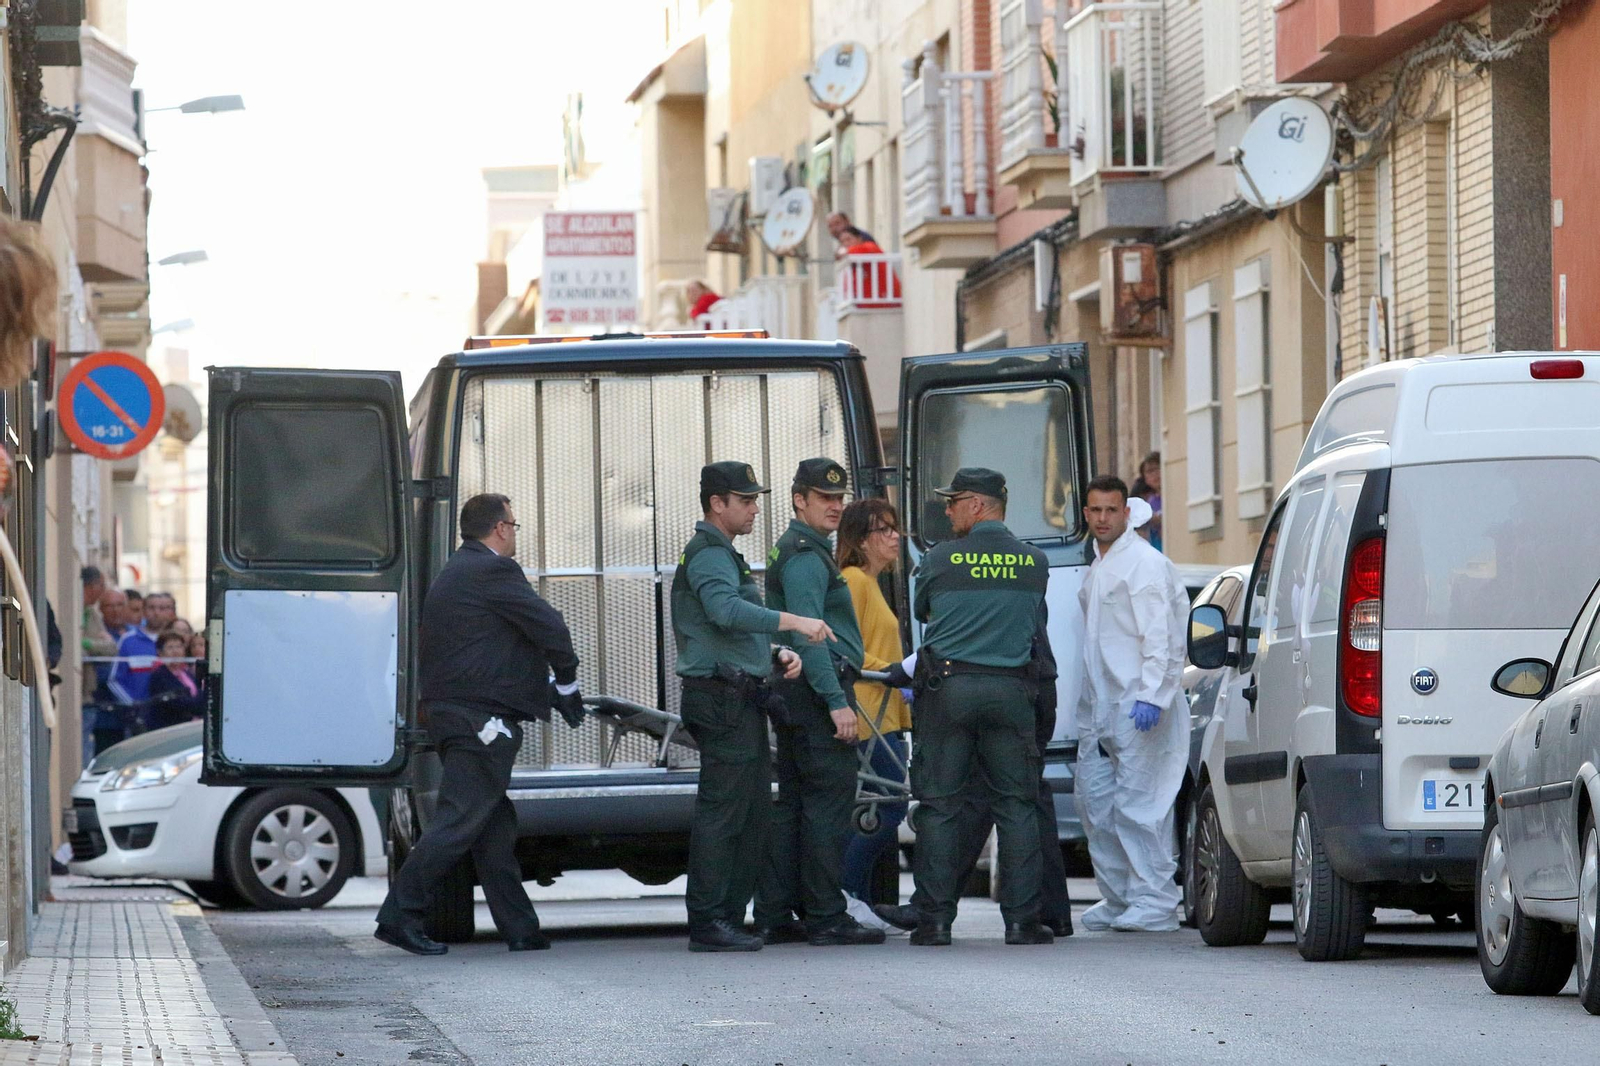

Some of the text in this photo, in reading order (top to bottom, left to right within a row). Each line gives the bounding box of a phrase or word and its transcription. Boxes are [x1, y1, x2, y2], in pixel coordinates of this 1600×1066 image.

[1278, 115, 1308, 140] Gi
[546, 214, 635, 234] SE ALQUILAN
[546, 236, 635, 253] APARTAMENTOS
[548, 287, 633, 300] DORMITORIOS
[92, 425, 124, 438] 16-31
[950, 552, 1035, 567] GUARDIA
[970, 566, 1018, 579] CIVIL
[1415, 676, 1434, 686] FIAT
[1426, 797, 1434, 805] E
